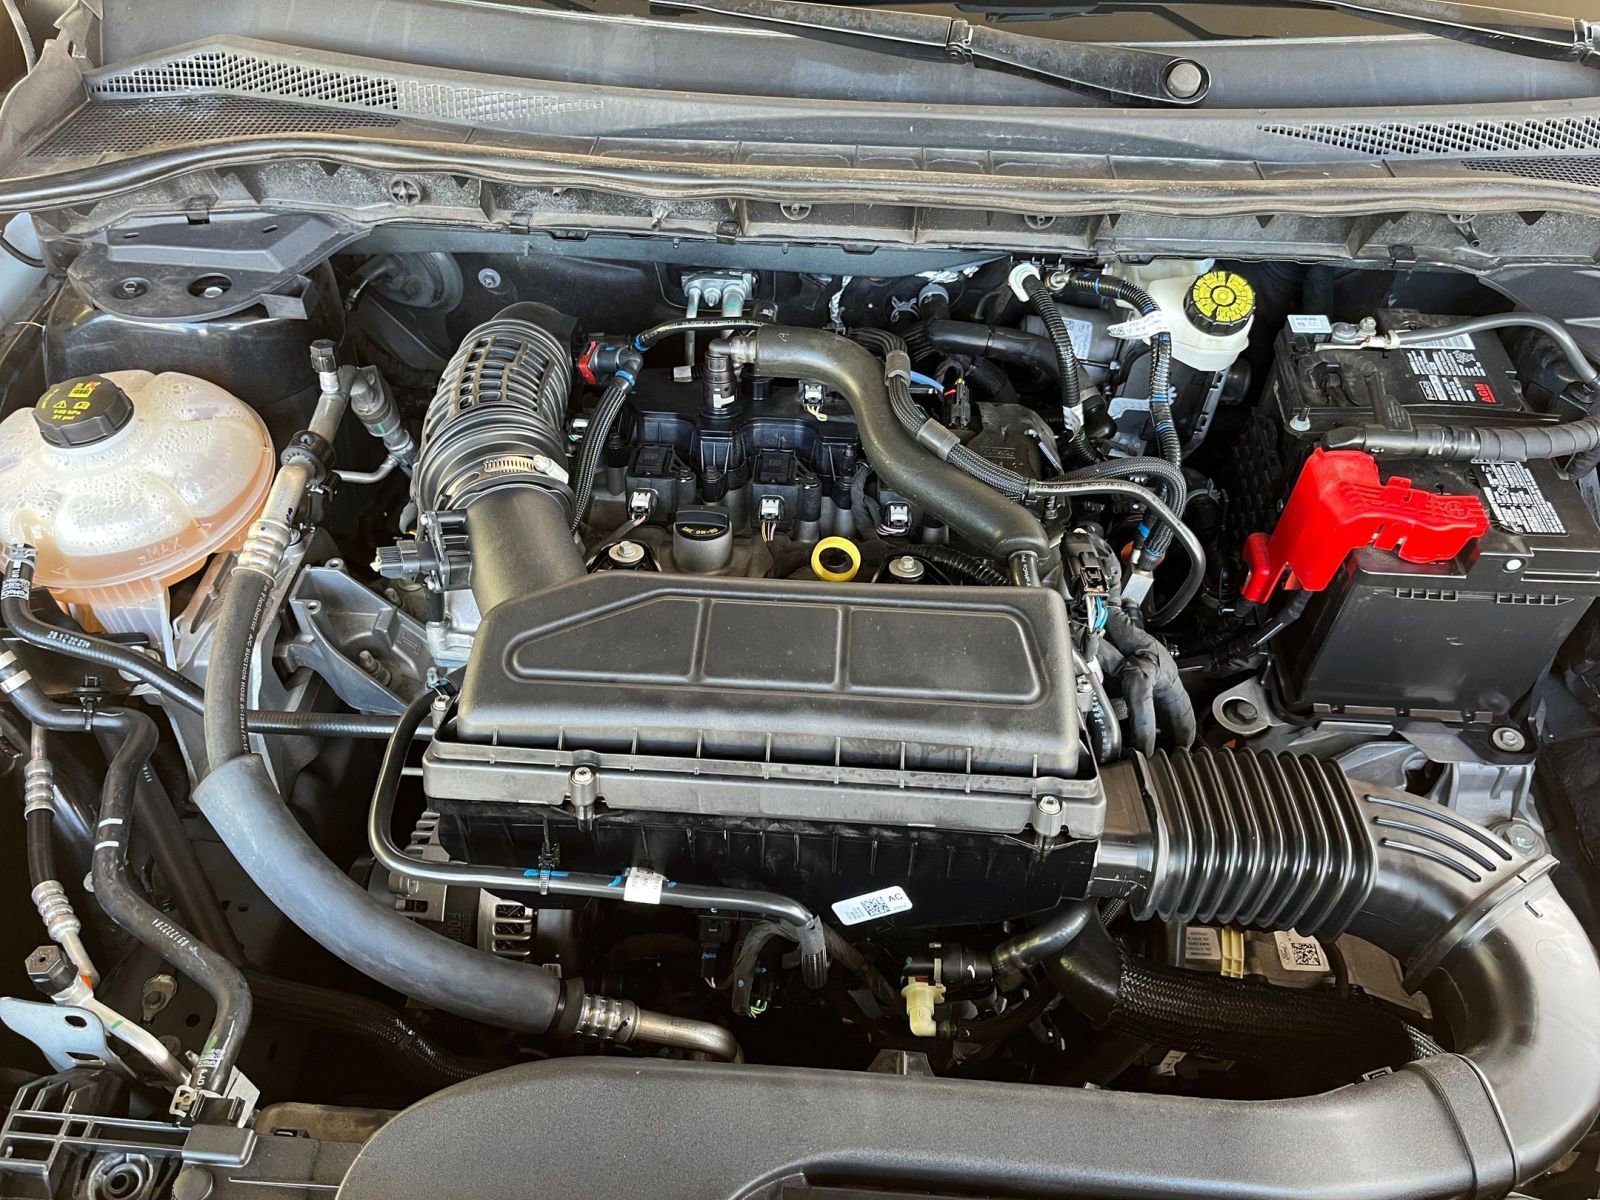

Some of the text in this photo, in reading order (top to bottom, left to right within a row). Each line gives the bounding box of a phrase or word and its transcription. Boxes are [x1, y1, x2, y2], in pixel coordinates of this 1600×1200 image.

[1474, 383, 1494, 403] AGM
[145, 537, 183, 560] MAX
[241, 647, 252, 680] SUCTION
[240, 681, 248, 702] HOSE
[888, 893, 903, 903] AC
